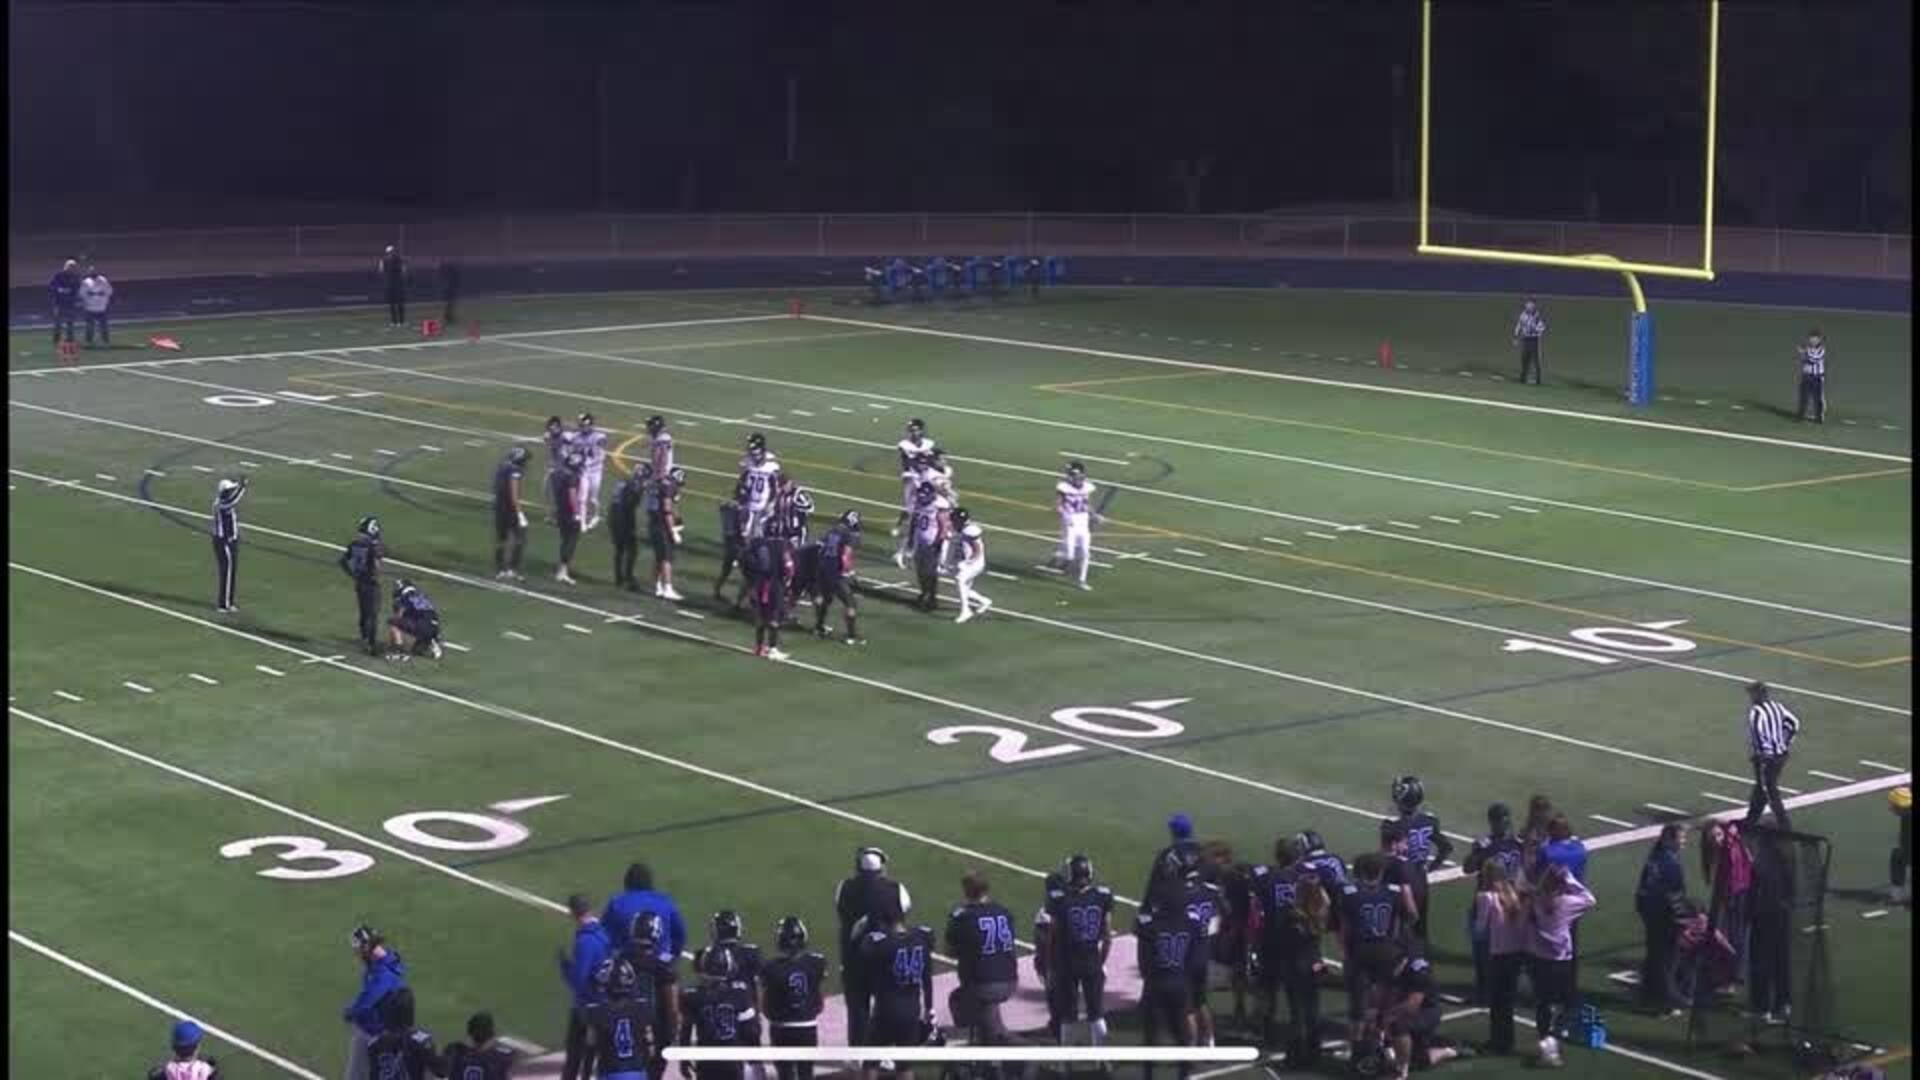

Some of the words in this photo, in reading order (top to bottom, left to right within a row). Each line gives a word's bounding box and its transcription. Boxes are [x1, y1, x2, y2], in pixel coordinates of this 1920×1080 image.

[1503, 627, 1696, 664] 10
[927, 706, 1184, 762] 20
[220, 811, 529, 879] 30
[978, 915, 1014, 955] 74
[895, 946, 925, 985] 44
